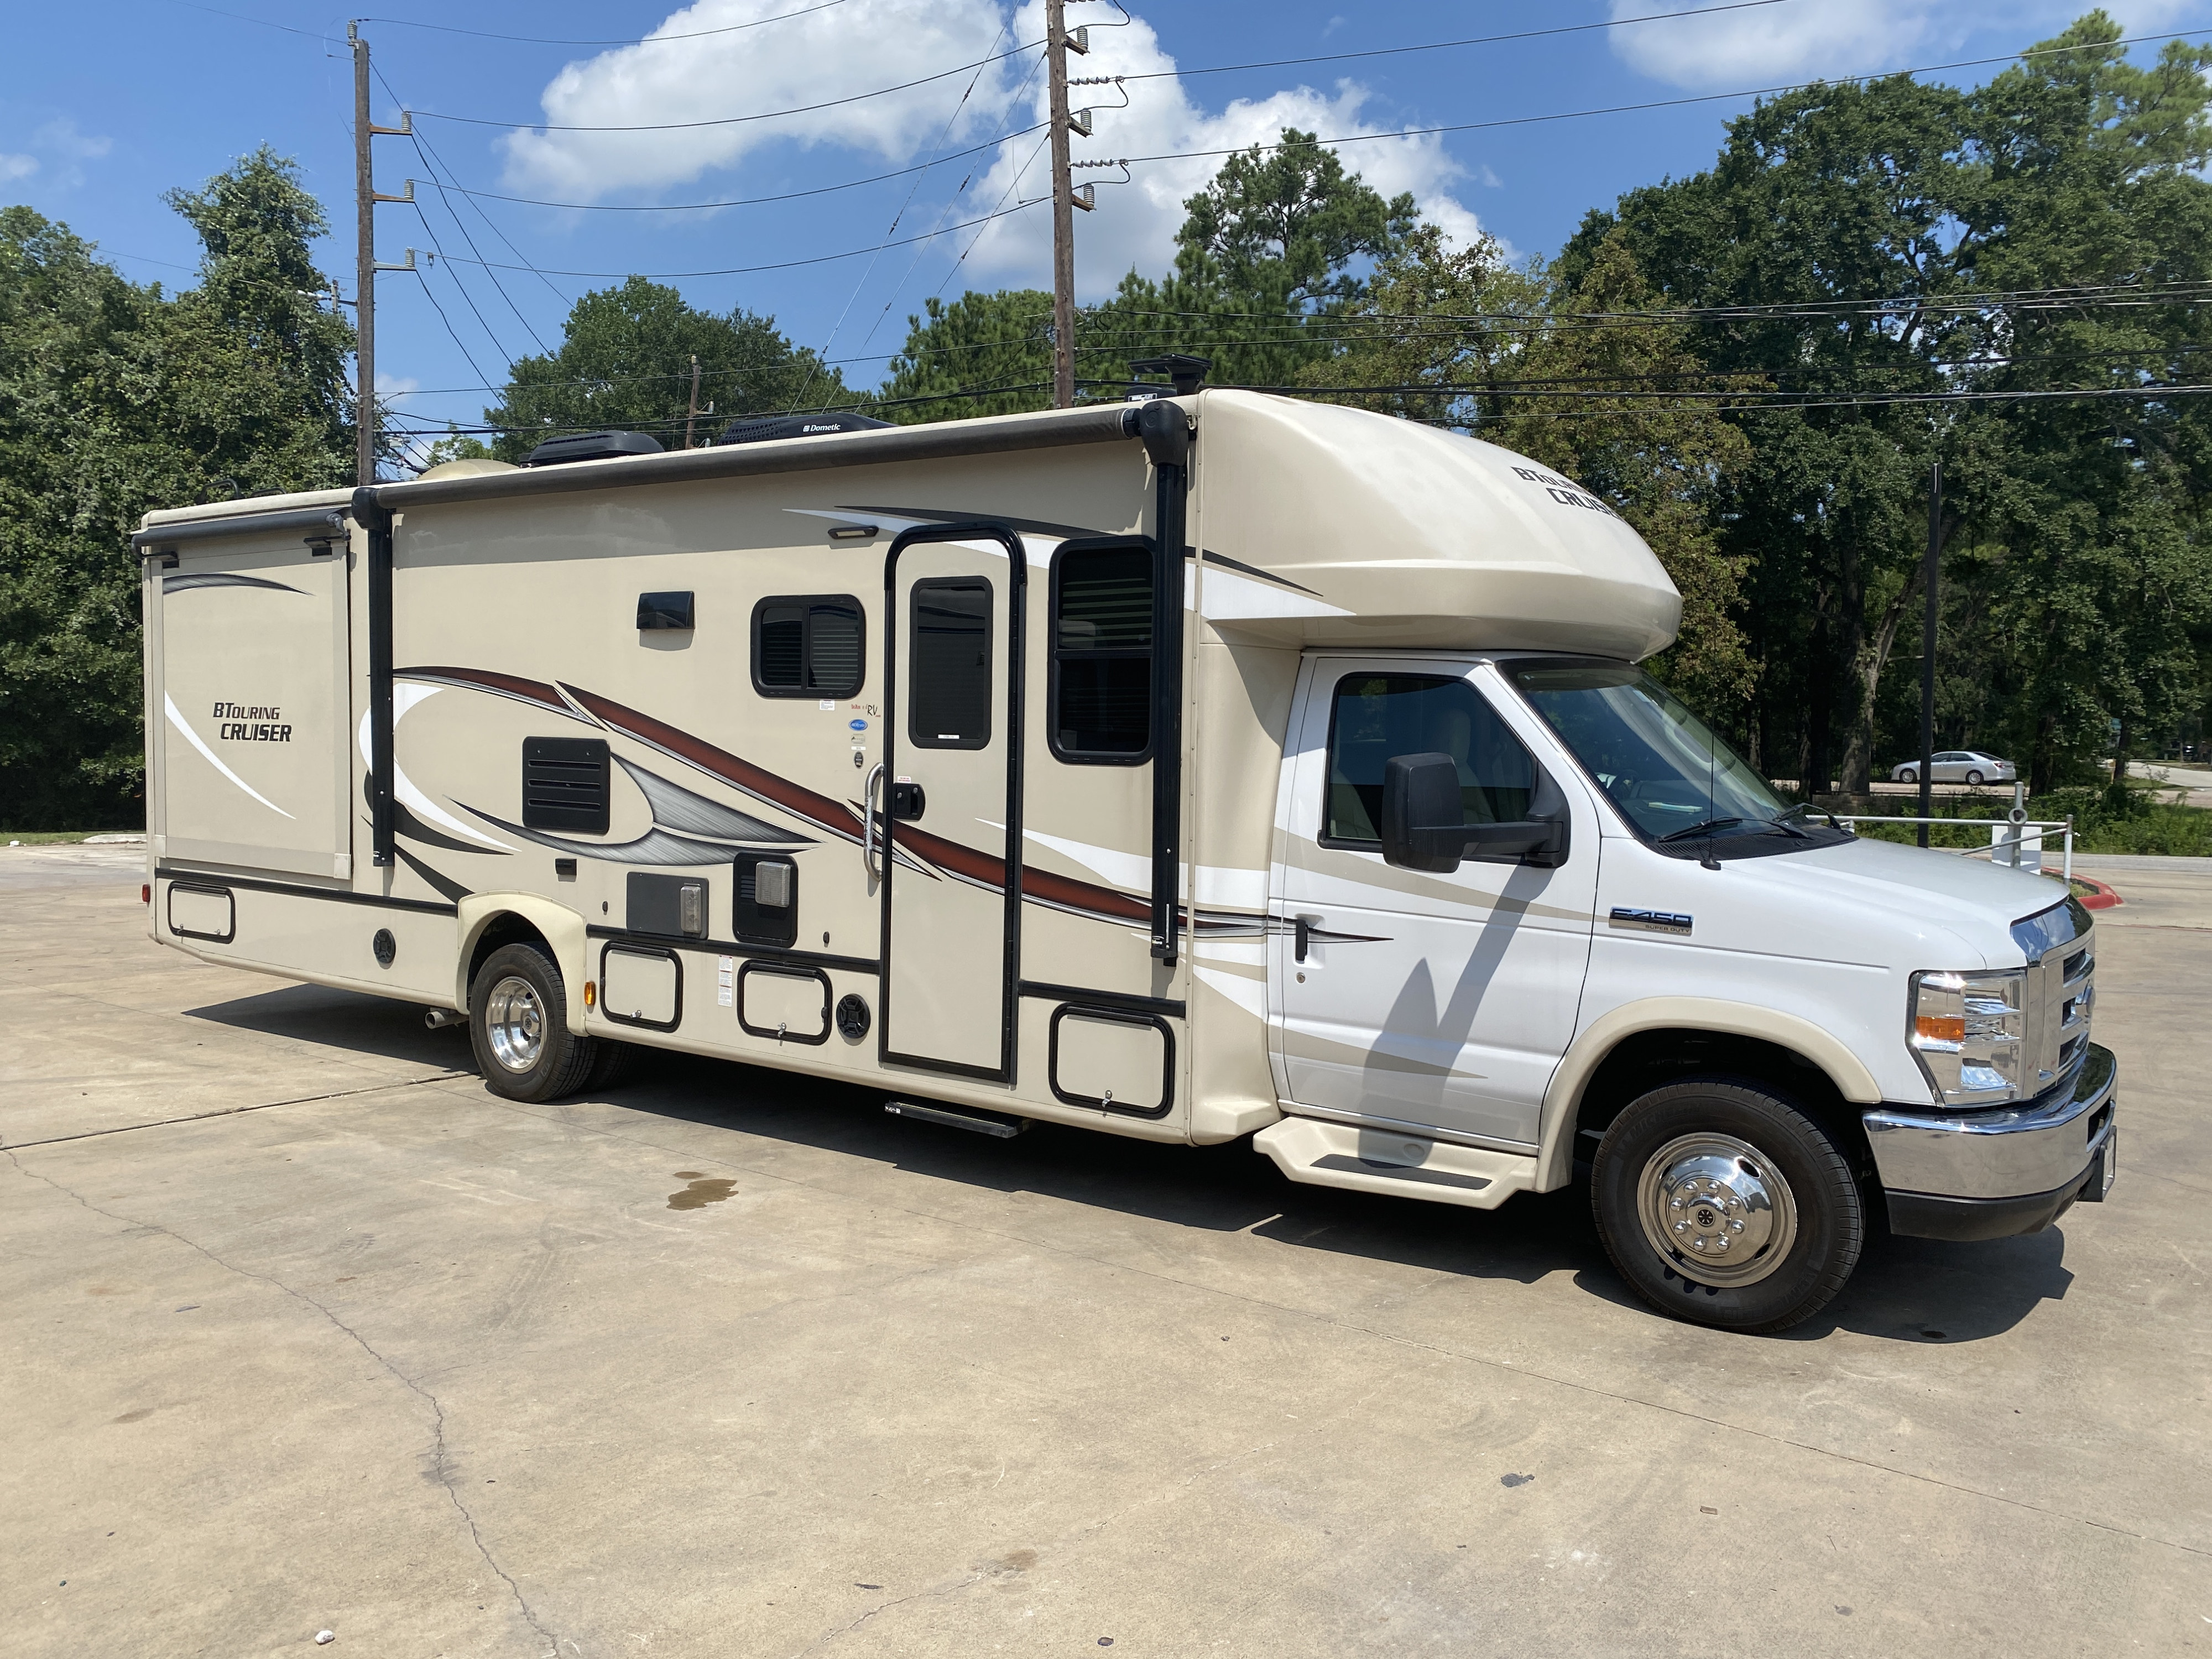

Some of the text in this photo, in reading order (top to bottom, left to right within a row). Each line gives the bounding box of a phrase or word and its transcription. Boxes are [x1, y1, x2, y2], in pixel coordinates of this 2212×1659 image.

[1546, 487, 1628, 523] CRUISE
[867, 705, 878, 716] RV
[221, 723, 292, 742] CRUISER
[1610, 909, 1693, 928] E-450
